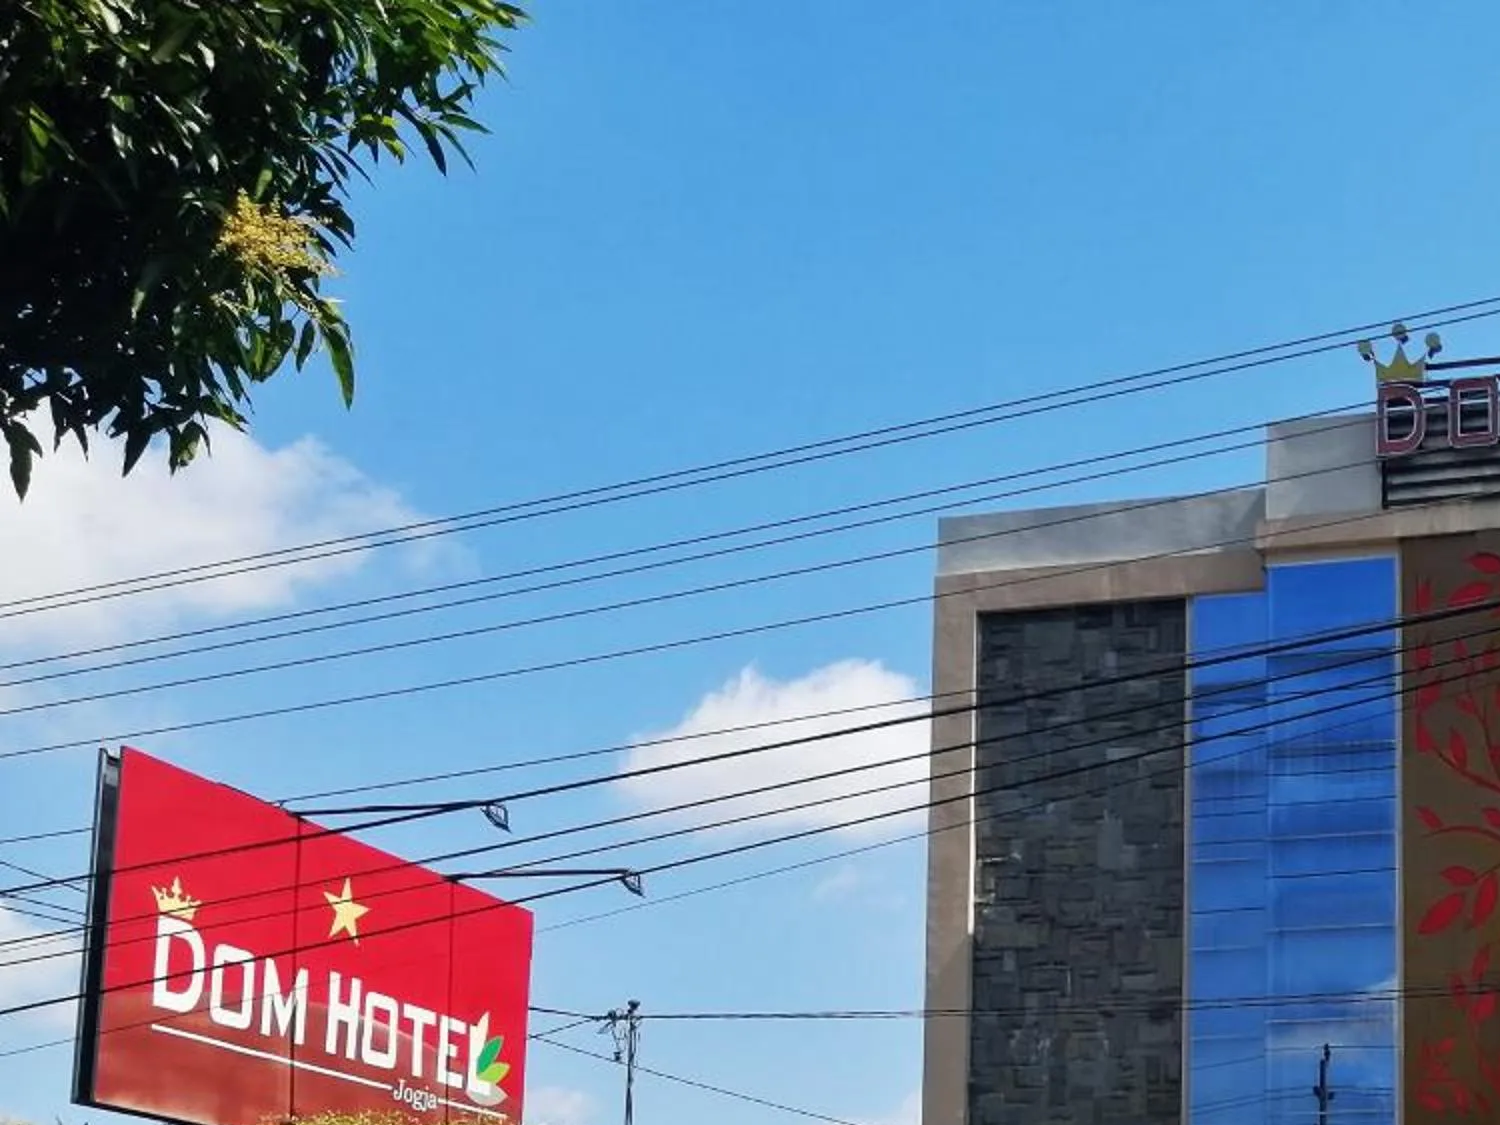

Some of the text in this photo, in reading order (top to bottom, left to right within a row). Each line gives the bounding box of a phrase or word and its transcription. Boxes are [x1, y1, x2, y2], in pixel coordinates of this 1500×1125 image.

[152, 915, 494, 1096] DOM HOTEL
[393, 1078, 438, 1112] Jogja
